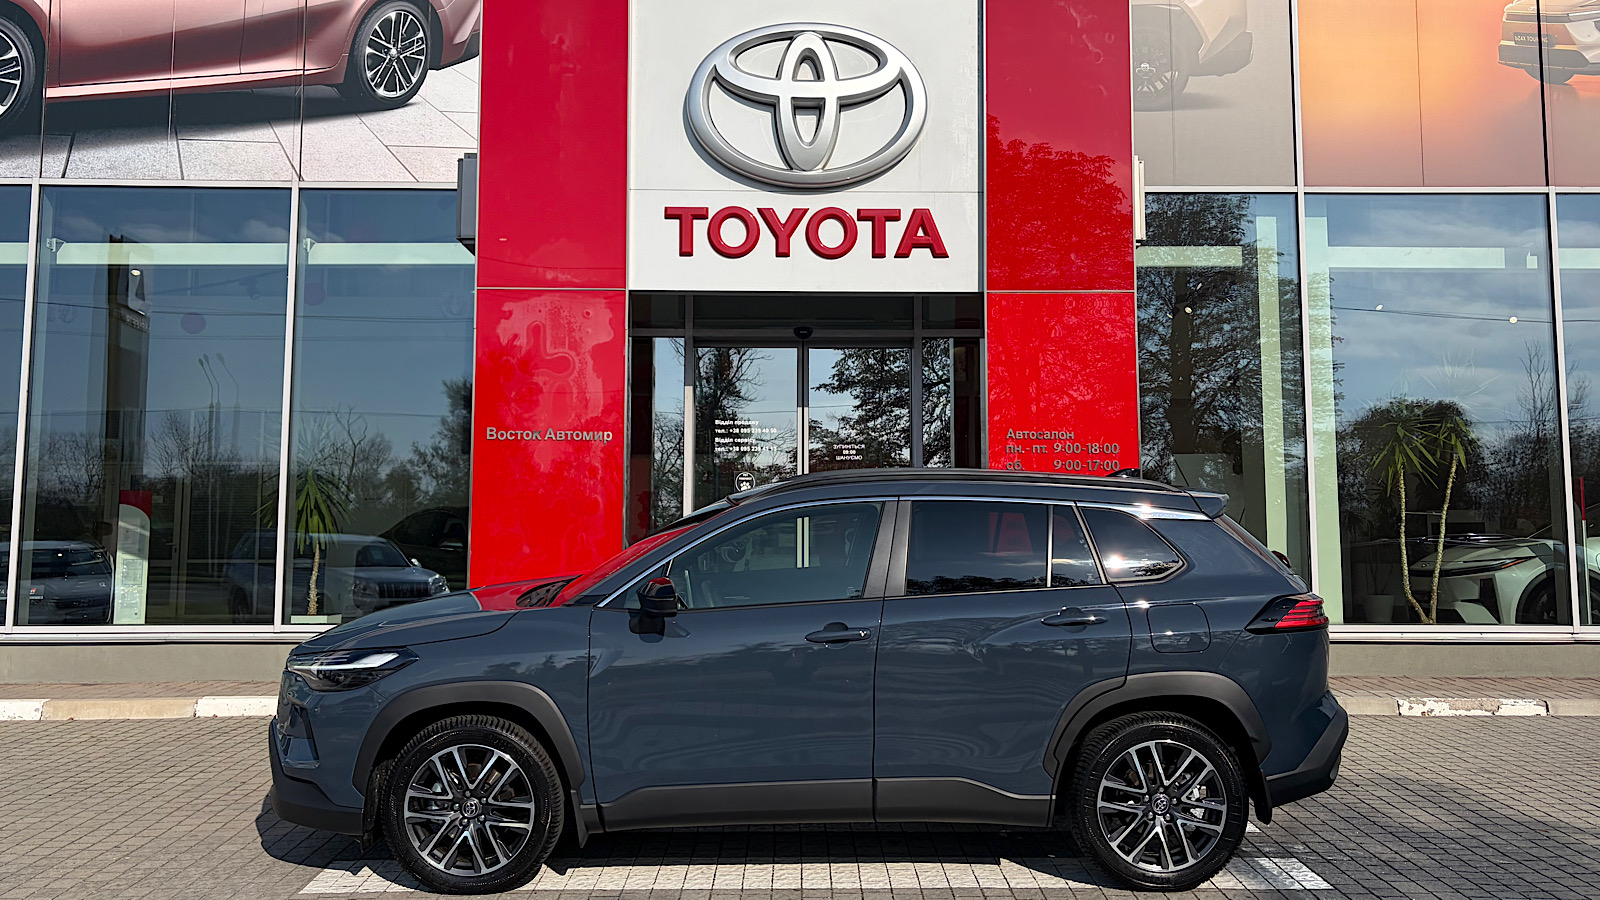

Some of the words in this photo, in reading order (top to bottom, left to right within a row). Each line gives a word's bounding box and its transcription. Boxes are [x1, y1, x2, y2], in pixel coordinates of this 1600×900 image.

[664, 206, 949, 259] TOYOTA
[486, 427, 542, 440] Восток
[544, 428, 613, 444] Автомир
[1006, 428, 1074, 440] Автосалон
[1053, 443, 1120, 454] 9:00-18:00
[1006, 460, 1025, 471] сб.
[1053, 460, 1120, 471] 9:00-17:00
